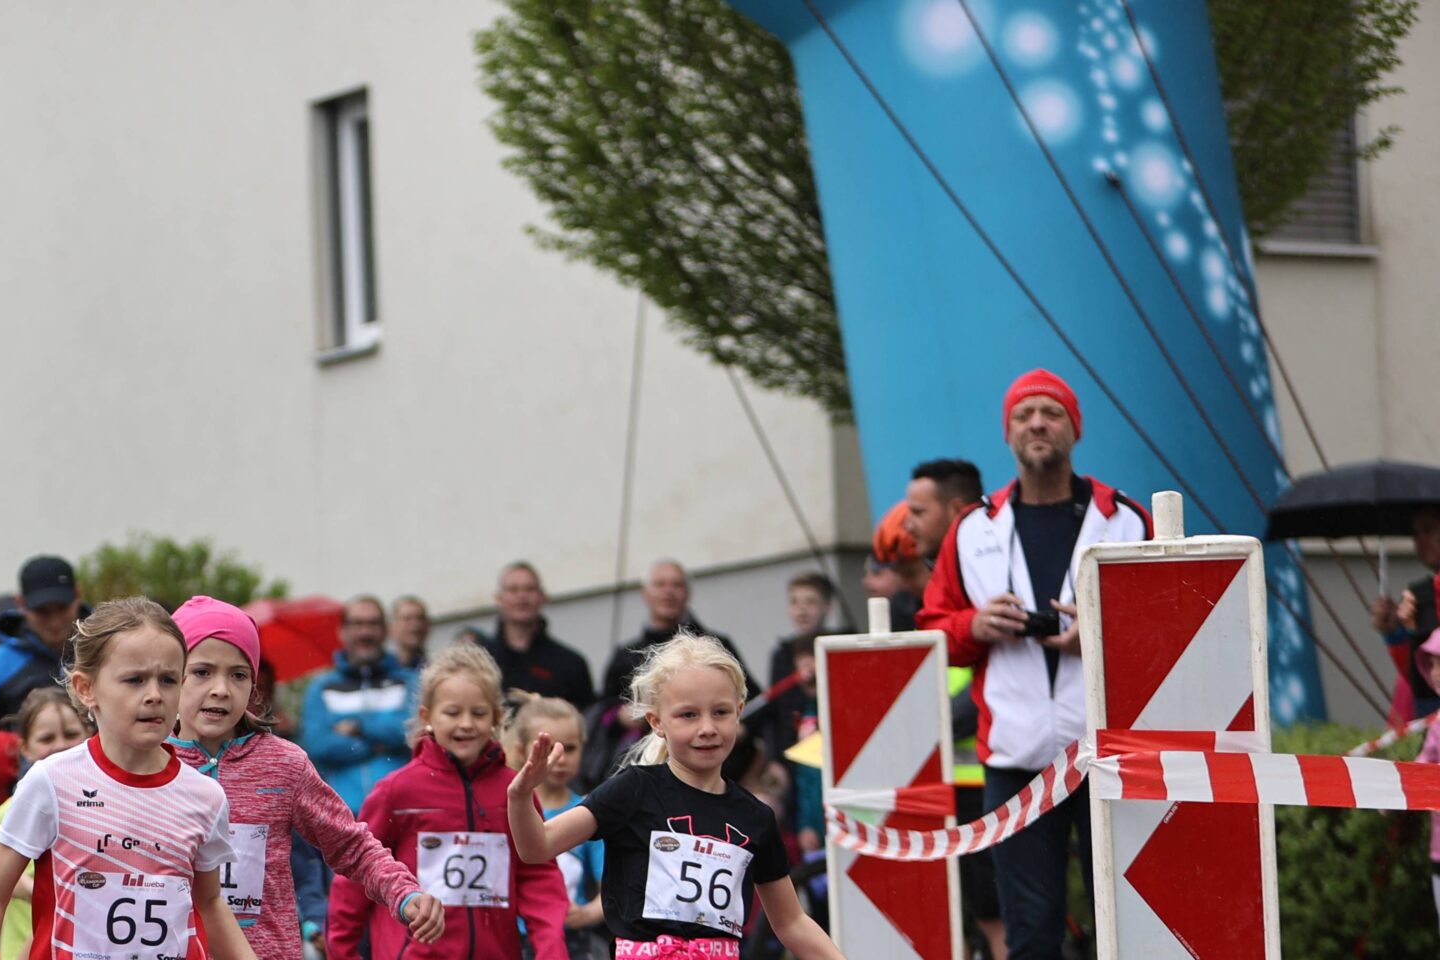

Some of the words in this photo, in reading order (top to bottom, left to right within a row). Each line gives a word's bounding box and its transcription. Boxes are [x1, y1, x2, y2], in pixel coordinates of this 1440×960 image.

[76, 800, 105, 808] erima
[144, 881, 166, 889] weba
[443, 854, 488, 890] 62
[676, 860, 733, 911] 56
[106, 897, 168, 947] 65
